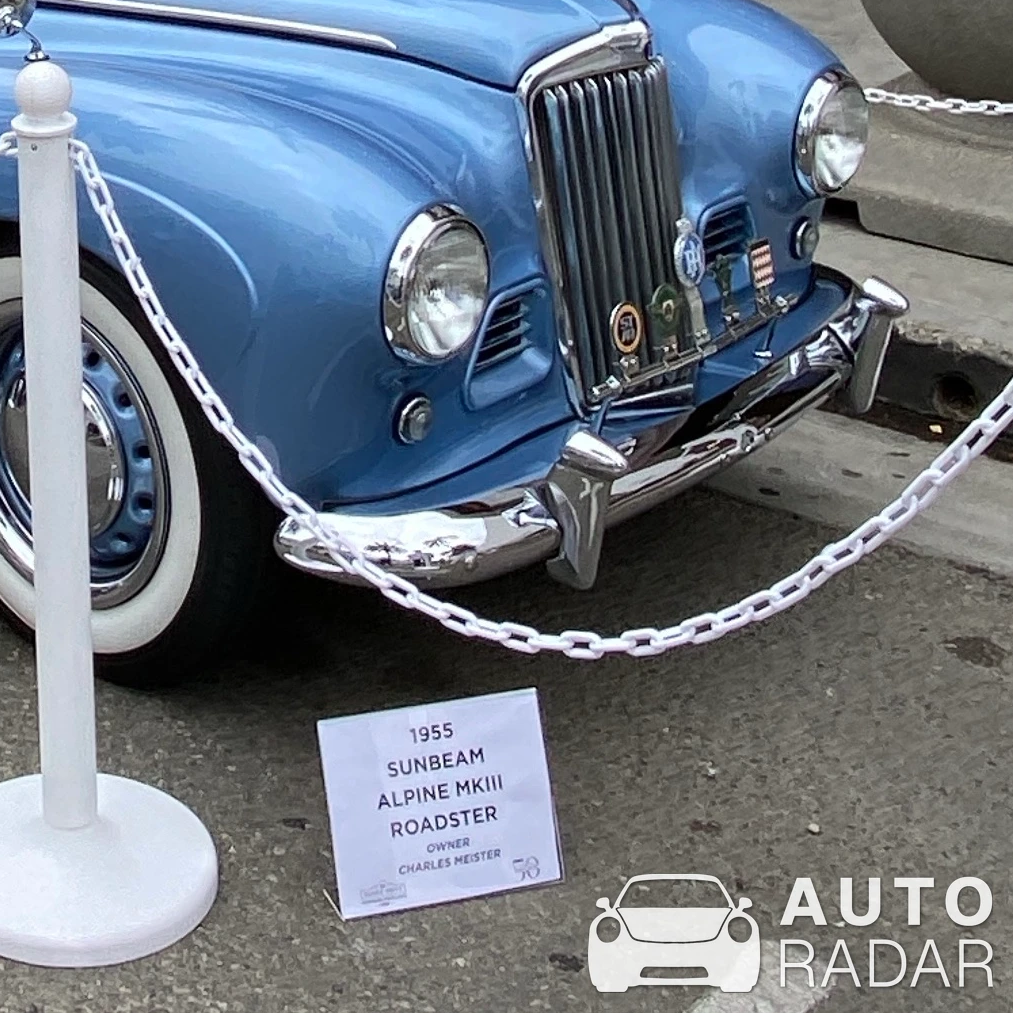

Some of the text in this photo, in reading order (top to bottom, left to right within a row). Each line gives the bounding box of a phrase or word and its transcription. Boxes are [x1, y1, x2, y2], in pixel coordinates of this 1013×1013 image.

[409, 722, 454, 744] 1955
[387, 747, 485, 778] SUNBEAM
[377, 774, 504, 810] ALPINE MKIII
[390, 805, 499, 838] ROADSTER
[426, 837, 470, 854] OWNER
[398, 848, 502, 876] CHARLES MEISTER
